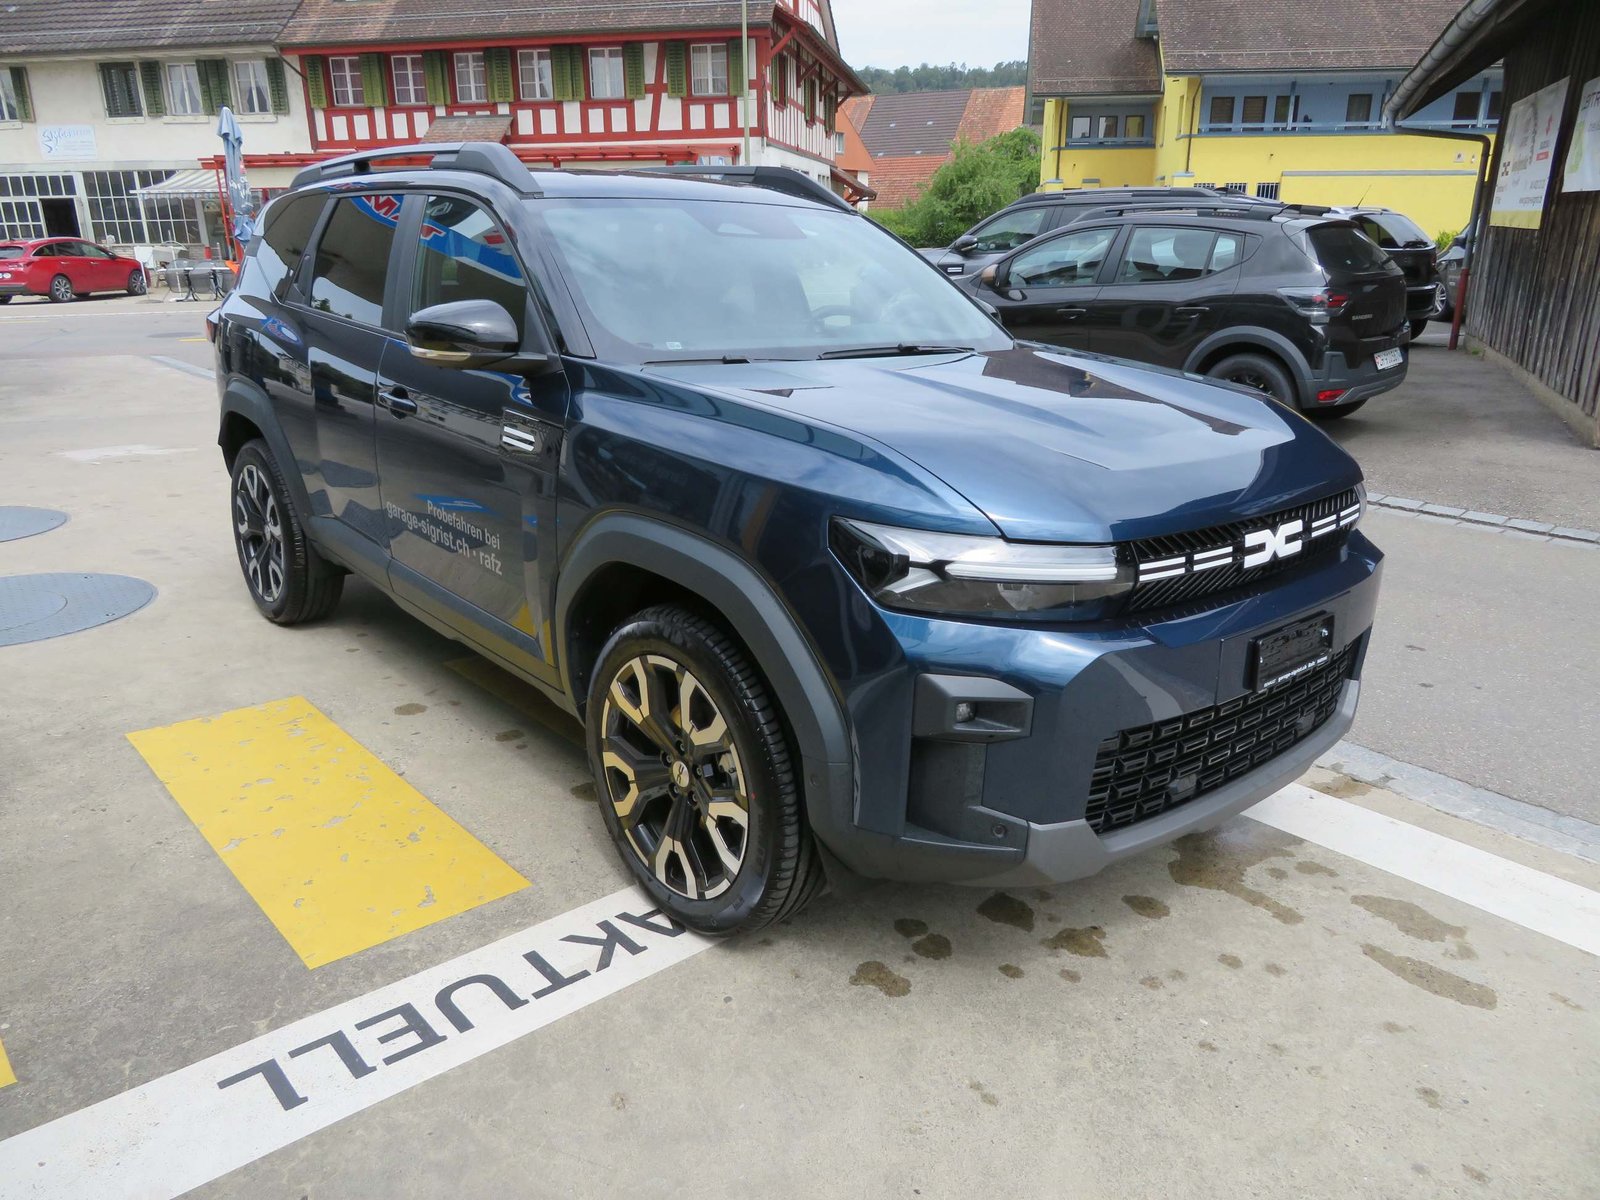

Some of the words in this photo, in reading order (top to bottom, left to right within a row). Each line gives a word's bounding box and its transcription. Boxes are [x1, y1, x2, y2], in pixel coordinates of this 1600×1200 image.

[386, 501, 470, 558] garage-sigrist.ch
[479, 550, 503, 575] rafz
[426, 499, 483, 541] Probefahren
[484, 528, 501, 549] bei
[216, 908, 687, 1112] AKTUELL
